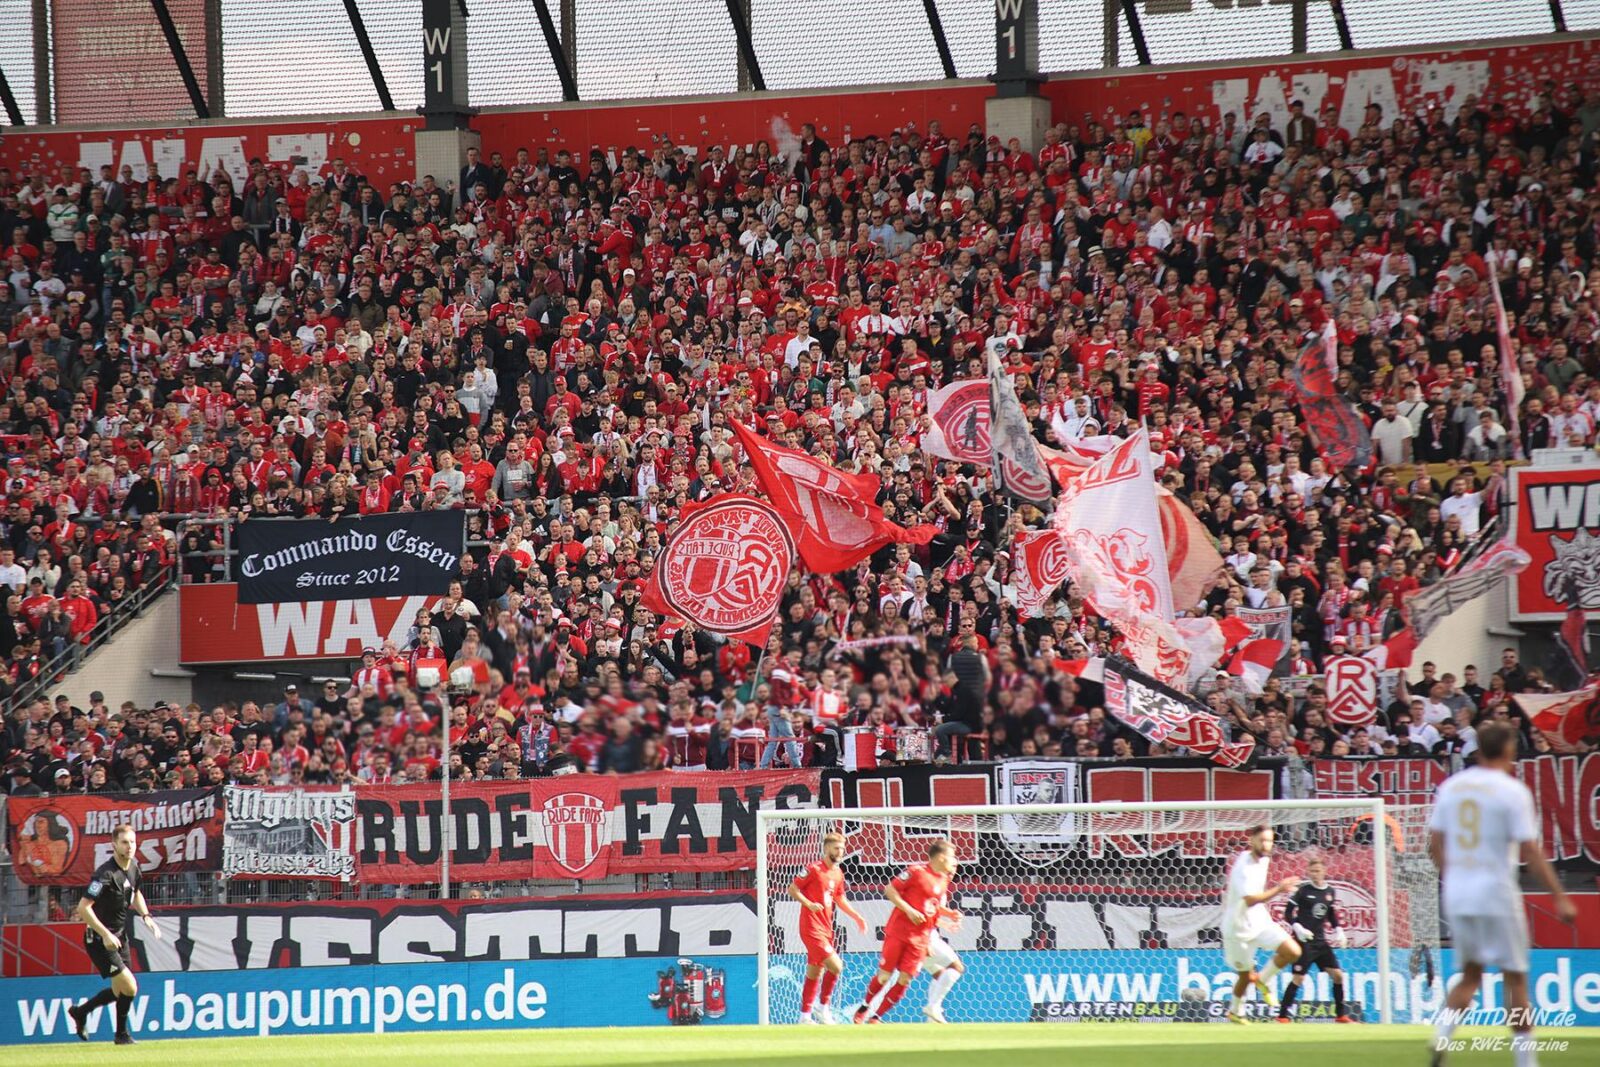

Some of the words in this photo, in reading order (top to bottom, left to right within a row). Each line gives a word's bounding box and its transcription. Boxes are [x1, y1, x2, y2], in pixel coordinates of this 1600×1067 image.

[423, 27, 451, 55] W
[1002, 26, 1015, 59] 1
[430, 62, 443, 92] 1
[241, 529, 377, 578] Commando
[386, 528, 458, 572] Essen
[296, 570, 350, 589] Since
[355, 565, 400, 585] 2012
[356, 793, 533, 865] RUDE
[620, 783, 812, 856] FANS
[548, 806, 578, 825] RUDE
[579, 805, 605, 825] FANS
[1457, 799, 1481, 850] 9
[94, 827, 208, 872] ESEN
[17, 968, 548, 1036] www.baupumpen.de
[1047, 1002, 1178, 1017] GARTENBAU
